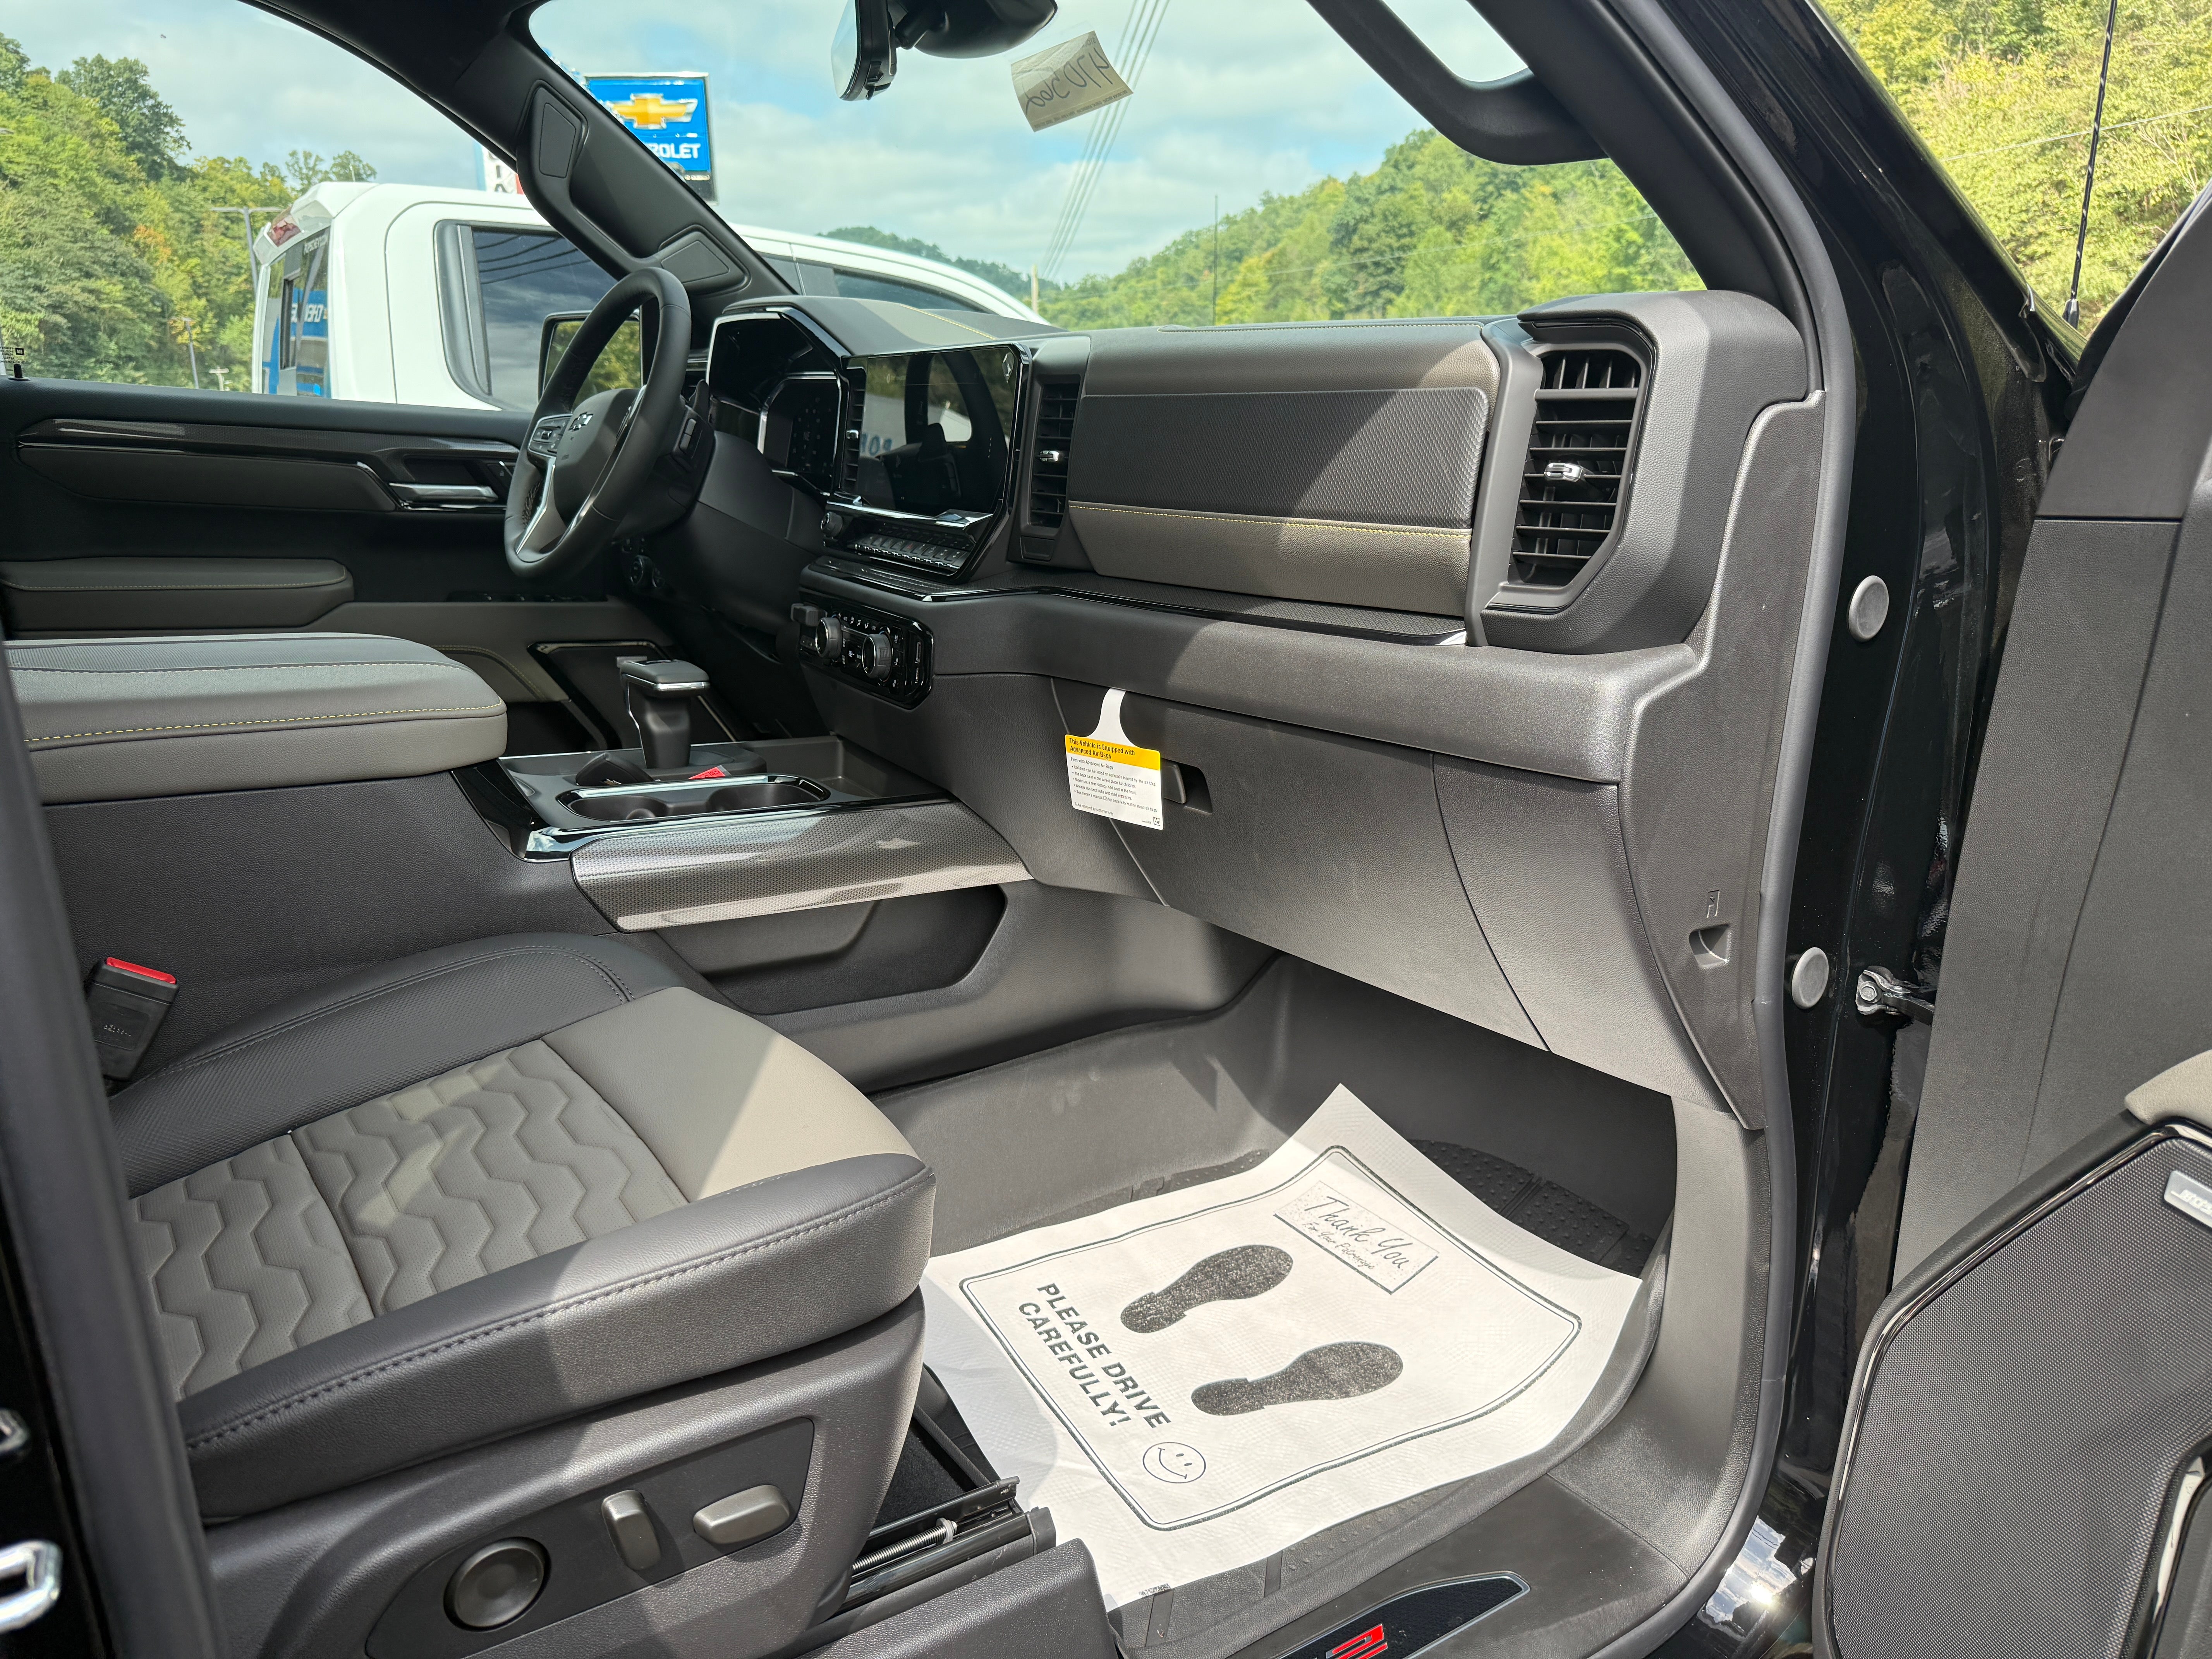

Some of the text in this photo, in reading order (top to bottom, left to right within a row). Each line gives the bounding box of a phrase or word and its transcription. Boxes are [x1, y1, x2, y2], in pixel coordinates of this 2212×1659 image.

[644, 143, 701, 159] ROLET
[1070, 746, 1091, 755] Advanced
[1100, 751, 1111, 759] Bags
[1080, 740, 1096, 749] Vehicle
[1102, 744, 1123, 754] Equipped
[1304, 1195, 1413, 1269] Thank You
[1019, 1302, 1131, 1426] CAREFULLY!
[1037, 1283, 1171, 1428] PLEASE DRIVE
